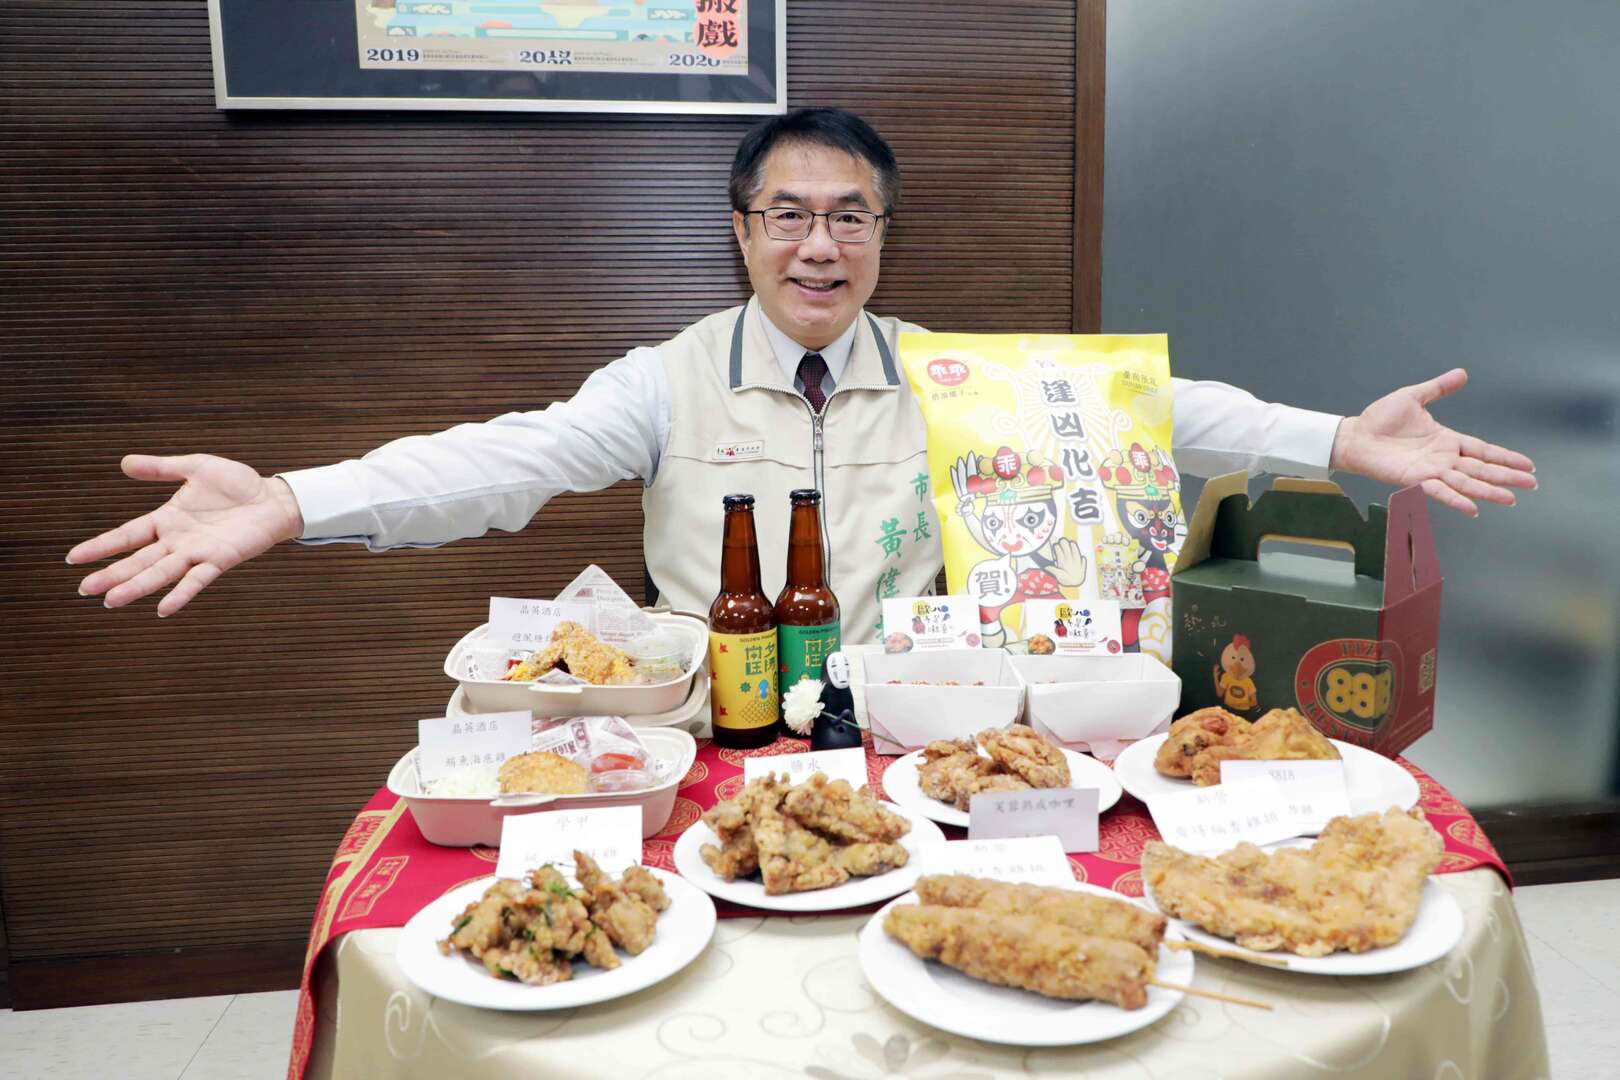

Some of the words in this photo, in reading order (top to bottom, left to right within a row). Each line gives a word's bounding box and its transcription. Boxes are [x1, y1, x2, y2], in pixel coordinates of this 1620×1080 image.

[367, 48, 419, 62] 2019
[669, 53, 721, 67] 2020
[928, 364, 966, 379] 乖乖
[1040, 379, 1100, 520] 逢凶化吉
[1131, 450, 1150, 470] 乖
[996, 453, 1018, 475] 乖
[909, 472, 931, 542] 市長
[974, 569, 1010, 599] 賀!
